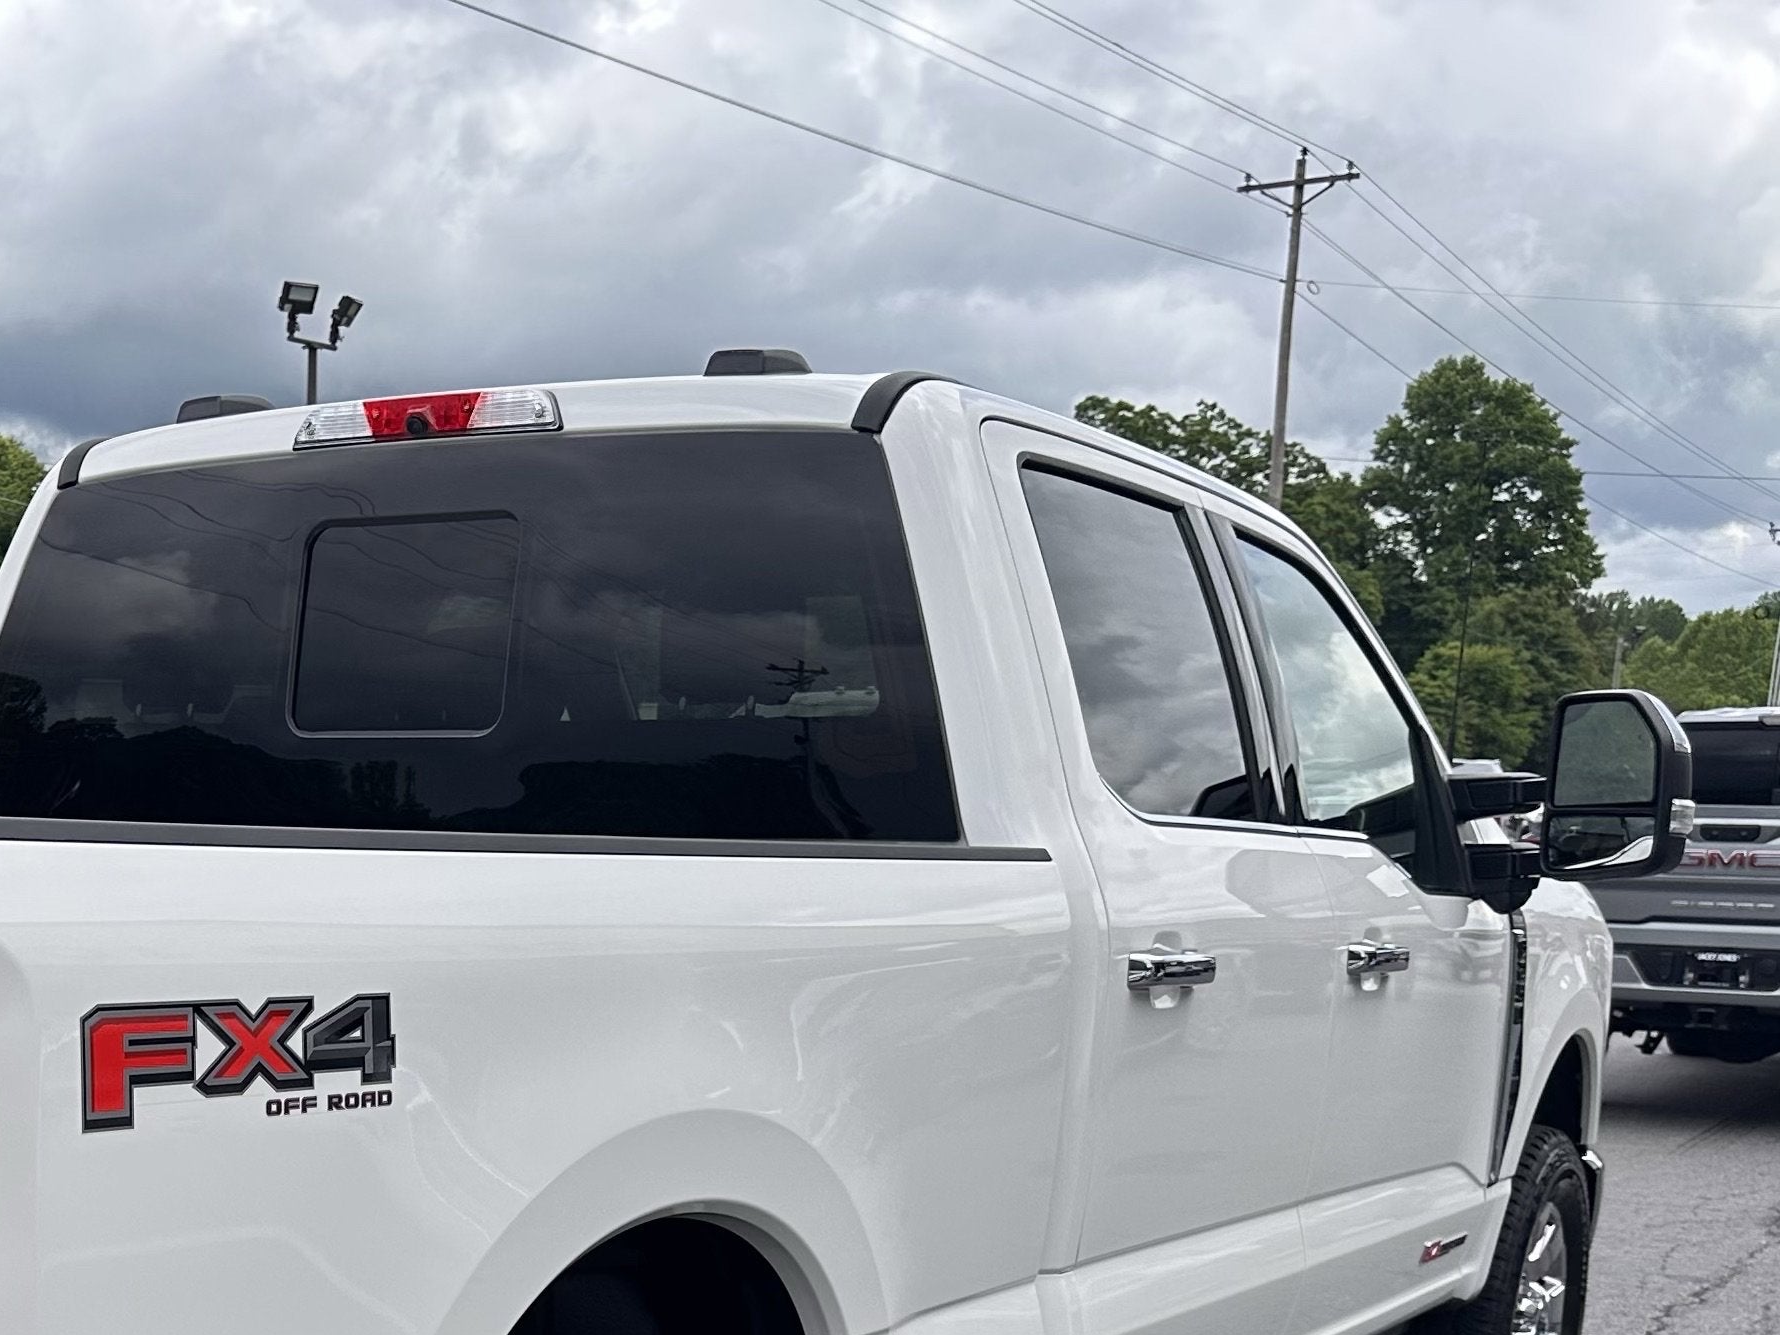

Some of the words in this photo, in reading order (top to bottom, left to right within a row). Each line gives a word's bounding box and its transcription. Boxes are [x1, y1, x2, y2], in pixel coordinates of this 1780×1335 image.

[80, 991, 396, 1134] FX4
[265, 1097, 318, 1117] OFF
[327, 1089, 393, 1113] ROAD
